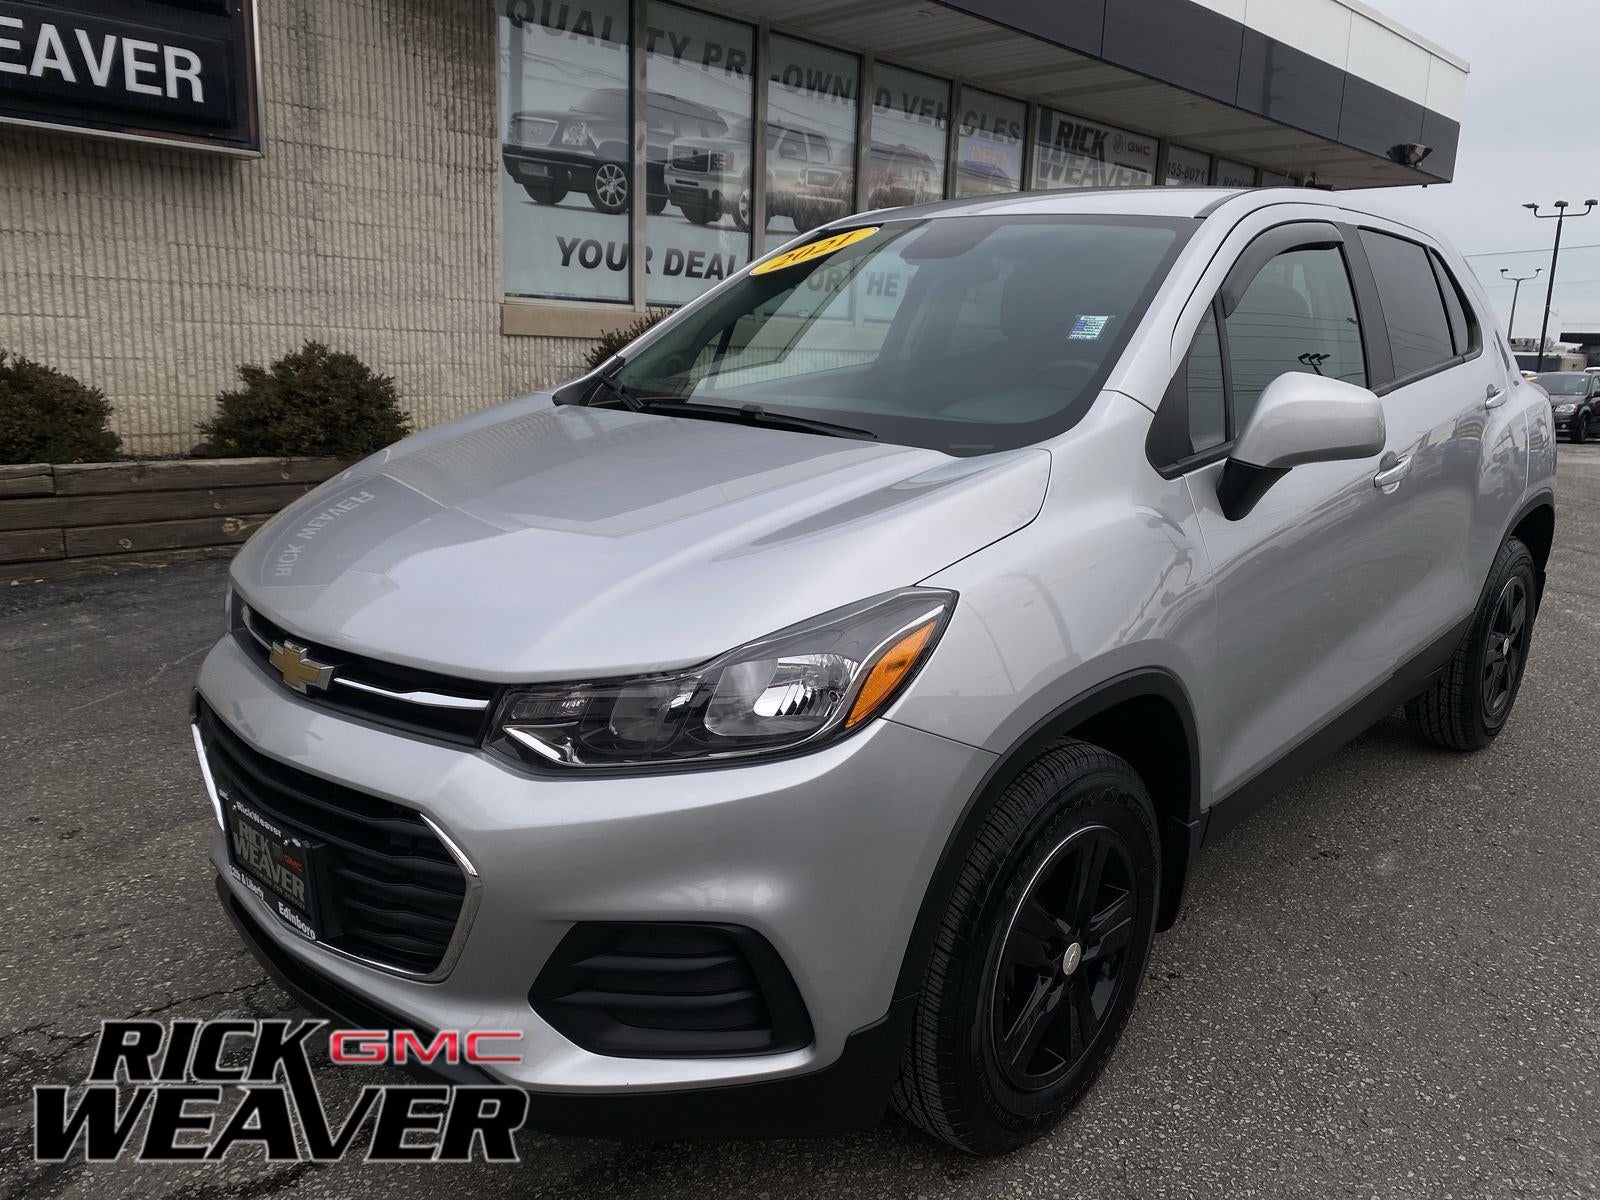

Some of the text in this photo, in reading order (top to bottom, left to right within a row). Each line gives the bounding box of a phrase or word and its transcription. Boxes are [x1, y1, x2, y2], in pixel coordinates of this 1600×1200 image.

[0, 16, 204, 103] EAVER
[505, 0, 1021, 145] QUALTY PR-OWND VEHCLES
[1054, 121, 1151, 161] RICK GMC
[662, 247, 736, 281] DEAL
[806, 267, 843, 292] OR
[866, 271, 900, 298] HE
[768, 231, 856, 269] 2021
[239, 819, 269, 856] RICK
[233, 832, 305, 904] WEAVER
